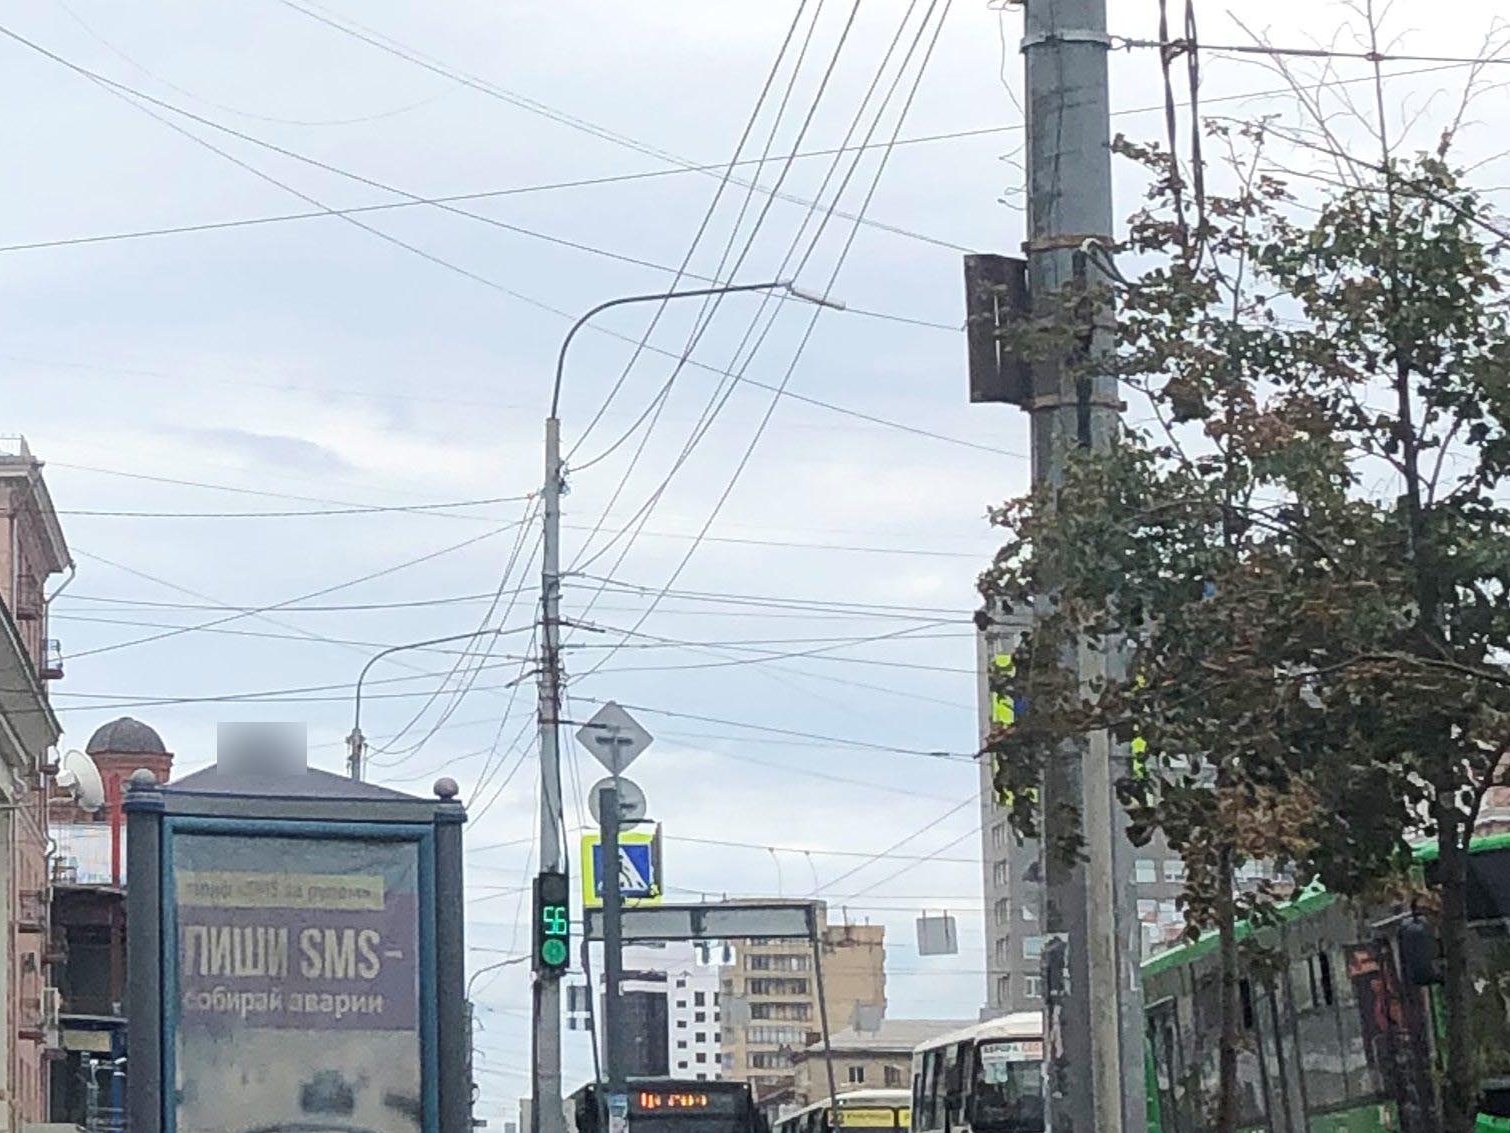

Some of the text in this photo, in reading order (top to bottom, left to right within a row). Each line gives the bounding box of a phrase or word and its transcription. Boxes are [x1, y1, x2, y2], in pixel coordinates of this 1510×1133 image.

[543, 905, 567, 935] 56
[184, 925, 289, 977] ПИШИ
[184, 986, 383, 1019] собирай аварии
